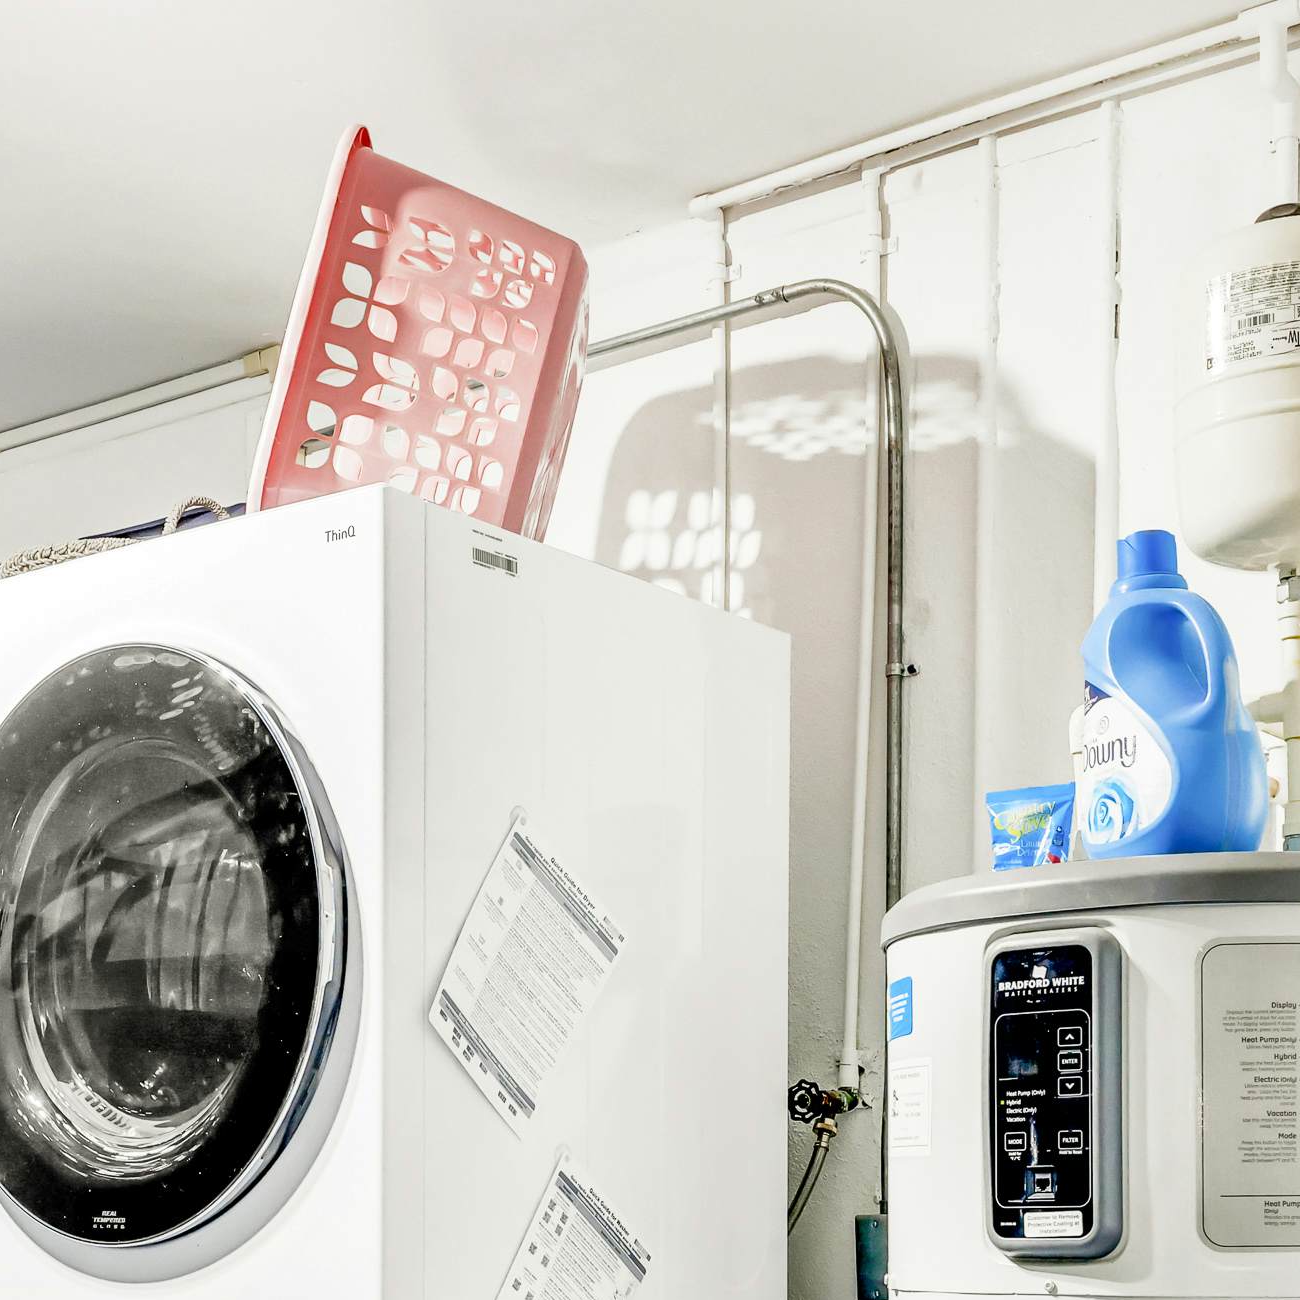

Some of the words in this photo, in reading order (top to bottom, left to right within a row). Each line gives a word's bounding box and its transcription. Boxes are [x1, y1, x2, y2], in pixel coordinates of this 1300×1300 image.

[325, 526, 356, 543] ThinQ
[999, 978, 1049, 991] BRADFORD
[1052, 976, 1085, 986] WHITE
[1271, 1002, 1297, 1010] Display
[1260, 1036, 1279, 1044] Pump
[1274, 1053, 1297, 1061] Hybrid
